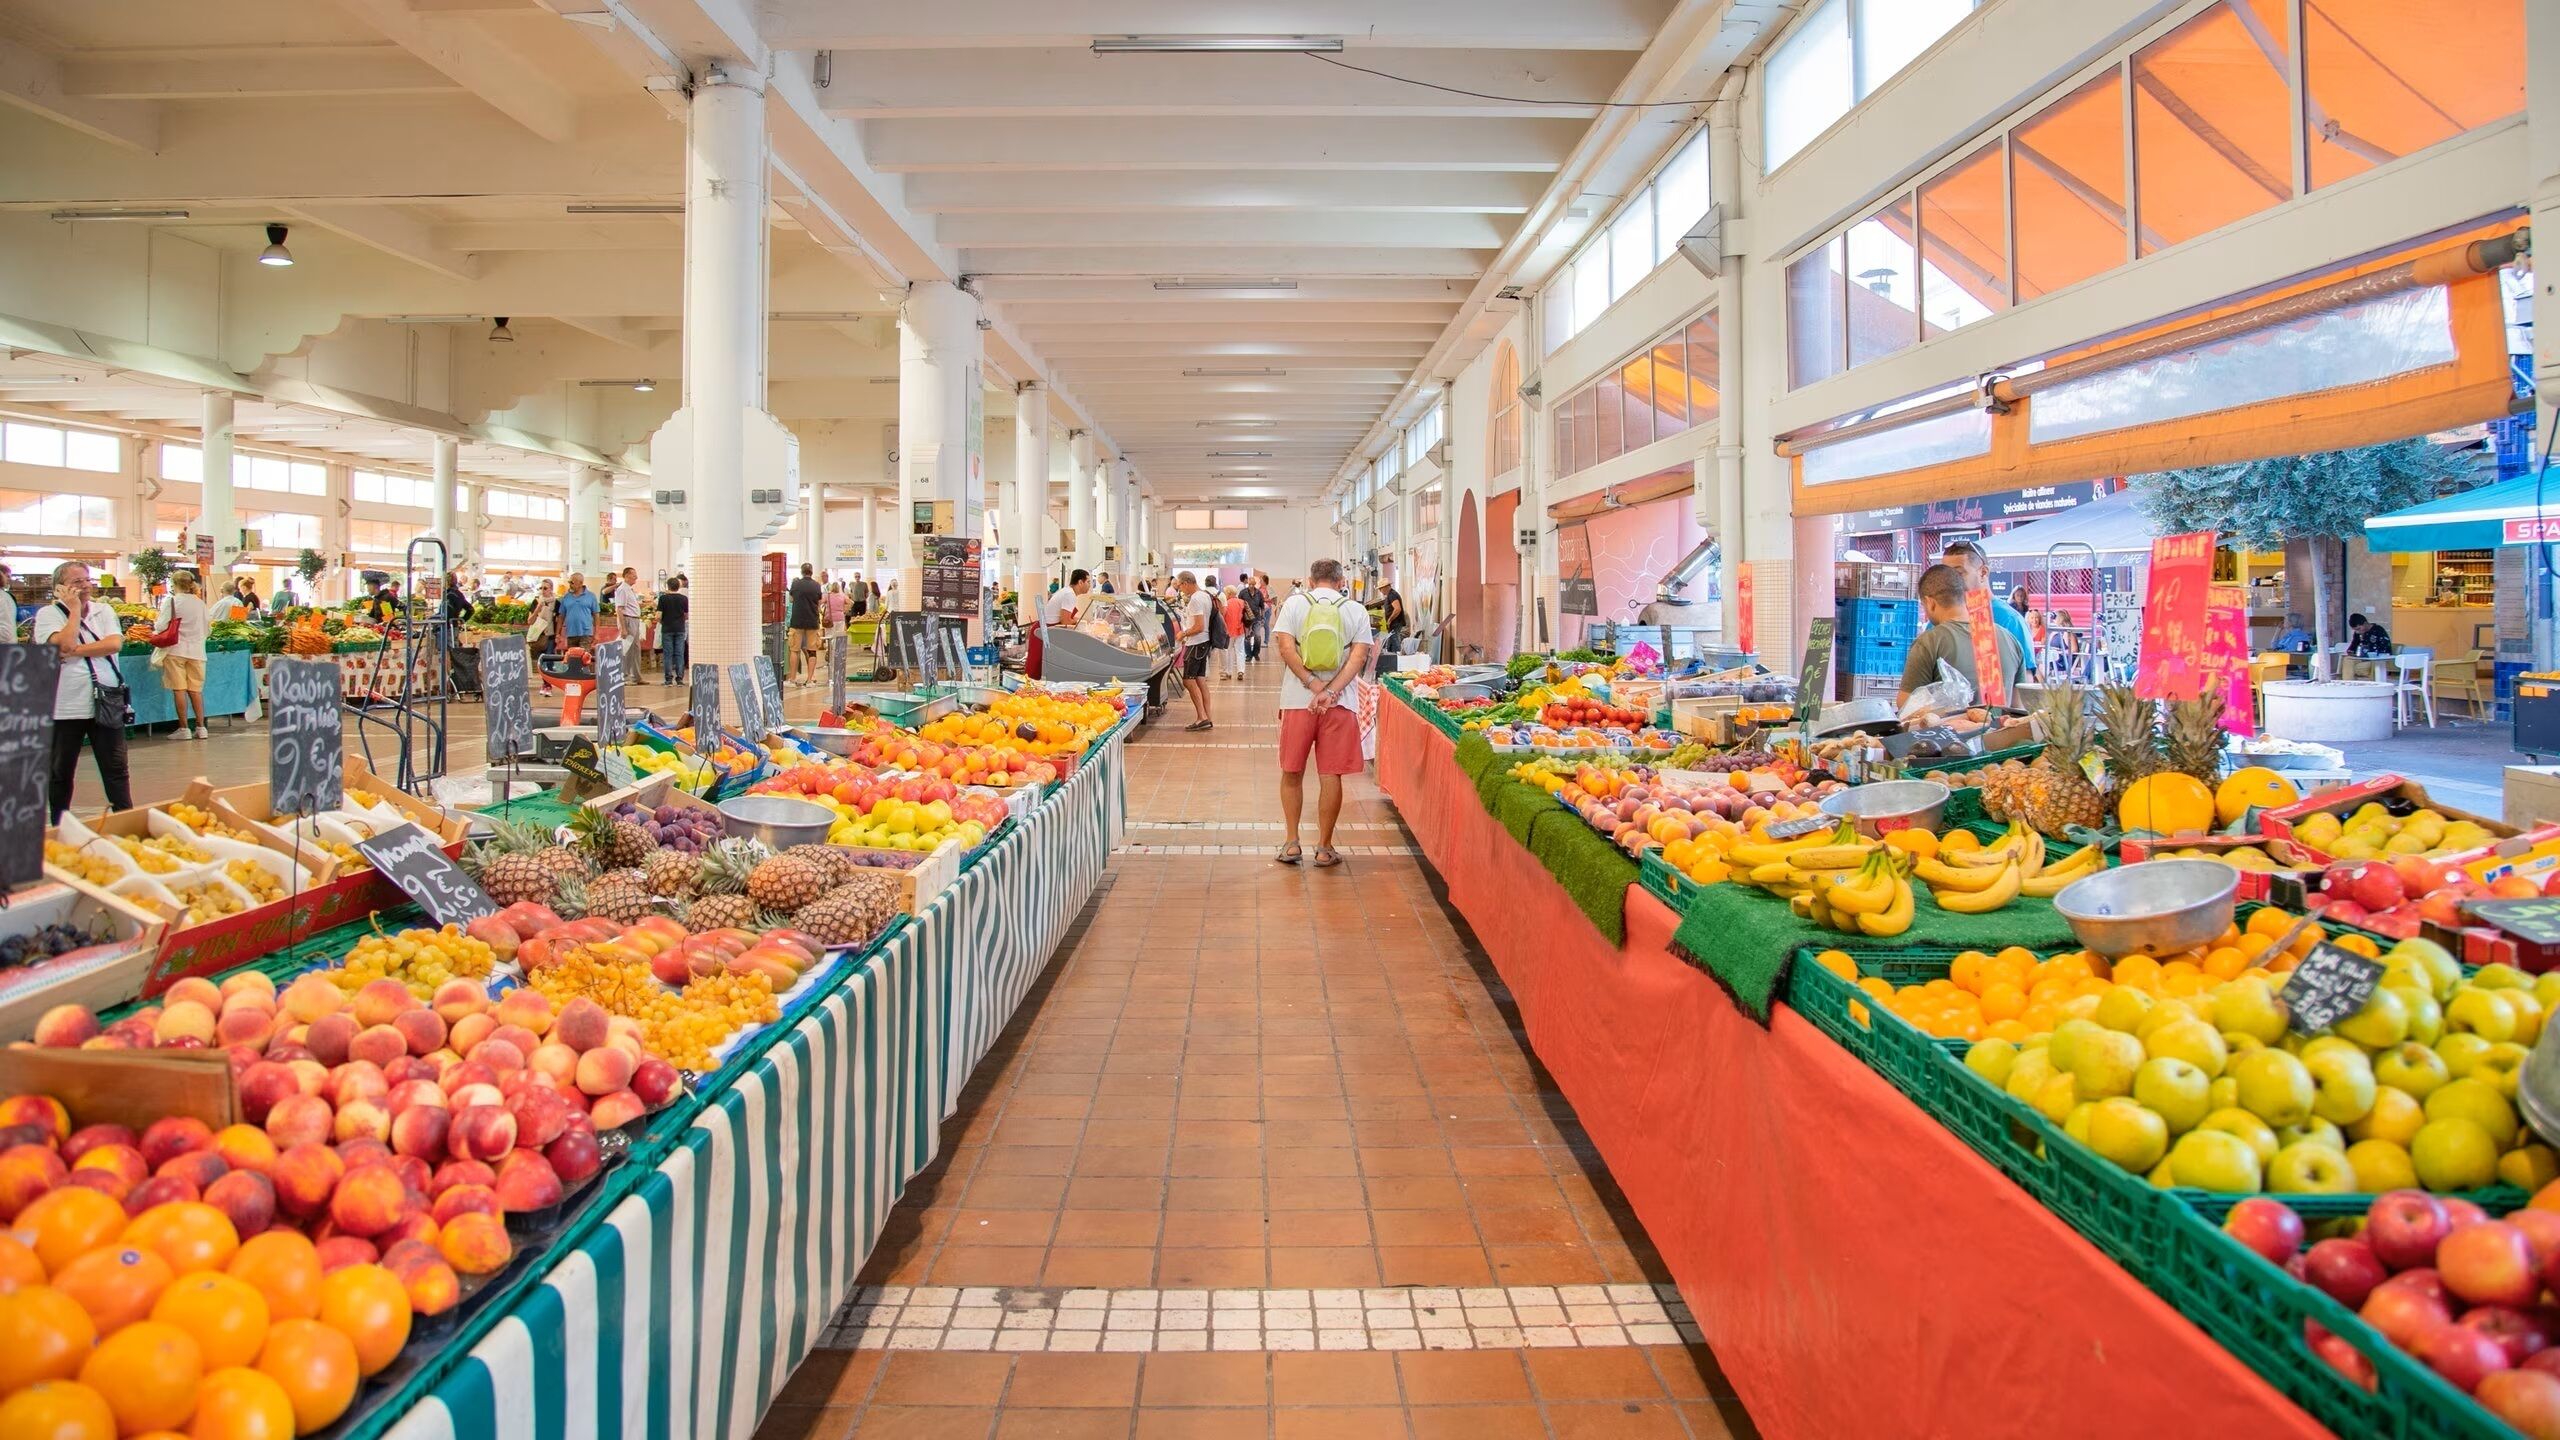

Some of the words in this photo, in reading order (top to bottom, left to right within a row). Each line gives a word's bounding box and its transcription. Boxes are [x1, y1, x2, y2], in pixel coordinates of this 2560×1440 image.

[1923, 500, 1953, 525] Maison
[486, 639, 525, 667] Ananas
[271, 667, 334, 706] Raisin
